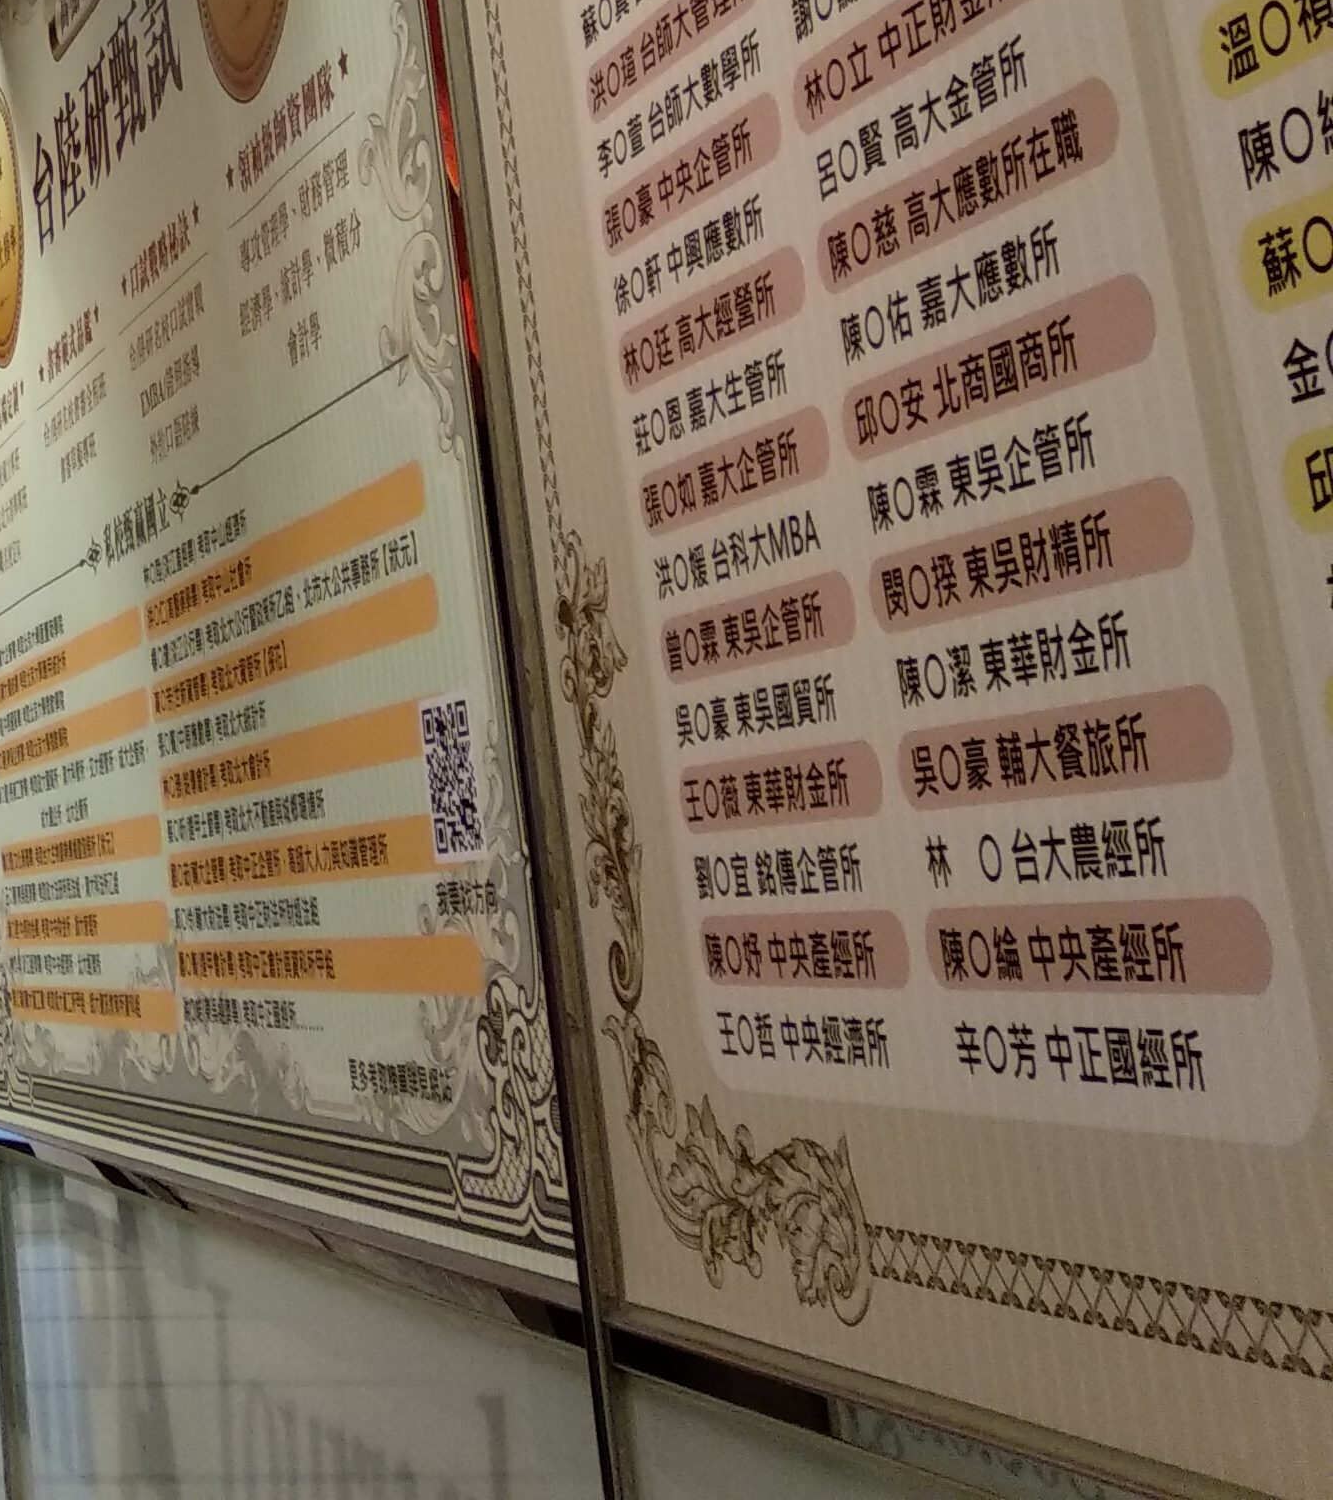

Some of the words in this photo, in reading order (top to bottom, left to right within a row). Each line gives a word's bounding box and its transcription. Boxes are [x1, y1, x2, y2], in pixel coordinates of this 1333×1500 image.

[647, 28, 762, 146] 台師大數學所
[891, 34, 1027, 159] 高大金管所
[657, 118, 753, 213] 中央企管所
[904, 108, 1083, 243] 高大應數所在職
[916, 219, 1060, 330] 嘉大應數所
[686, 348, 788, 433] 嘉大生管所
[933, 315, 1078, 419] 北商國商所
[697, 426, 801, 507] 嘉大企管所
[946, 411, 1095, 506] 東吳企管所
[712, 510, 822, 584] 台科大MBA
[963, 510, 1114, 598] 東吳財精所
[721, 590, 825, 659] 東吳企管所
[980, 610, 1131, 692] 東華財金所
[734, 673, 837, 737] 東吳國貿所
[744, 757, 851, 815] 東華財金所
[997, 712, 1149, 790] 輔大餐旅所
[755, 843, 863, 897] 銘傳企管所
[1012, 816, 1168, 884] 台大農經所
[767, 930, 877, 981] 中央產經所
[1028, 922, 1188, 984] 中央產經所
[780, 1013, 891, 1070] 中央經濟所
[1045, 1024, 1206, 1093] 中正國經所
